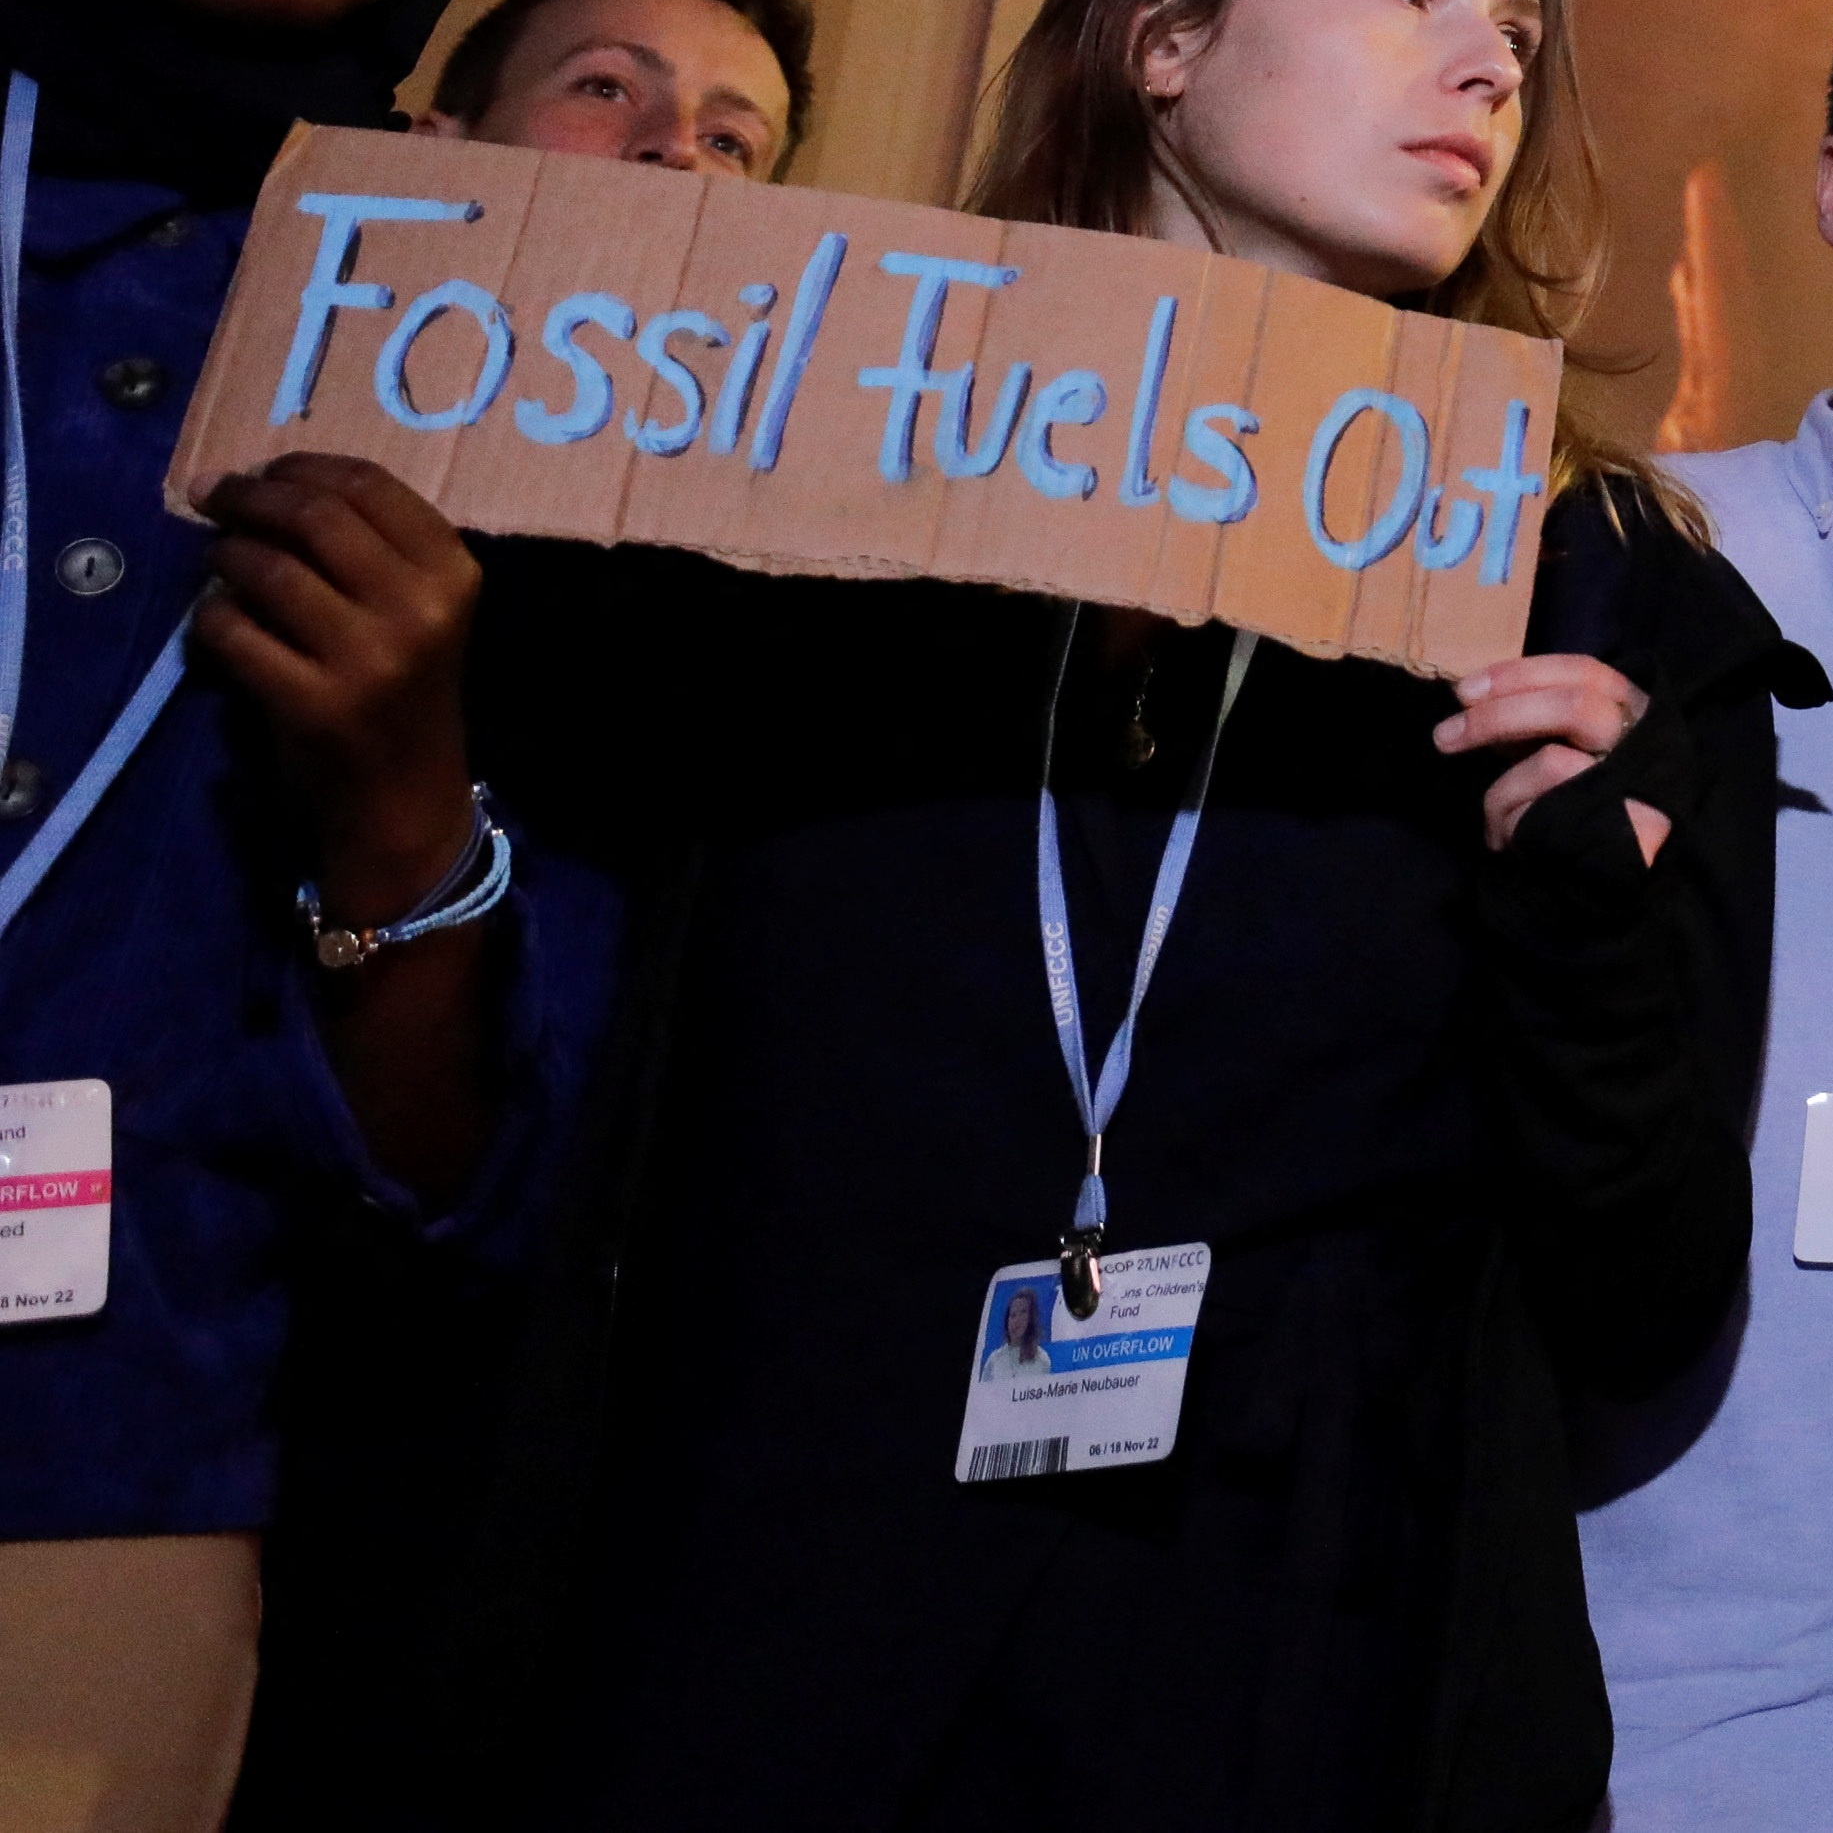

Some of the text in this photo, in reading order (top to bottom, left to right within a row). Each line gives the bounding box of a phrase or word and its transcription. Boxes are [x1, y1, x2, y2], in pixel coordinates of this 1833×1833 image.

[269, 191, 1542, 584] Fossil Fuels Out
[1044, 920, 1075, 1028] UNFCCC
[1104, 1260, 1134, 1275] COP
[16, 1294, 49, 1308] Nov
[55, 1289, 74, 1304] 22
[1146, 1281, 1206, 1298] Children's
[1110, 1304, 1141, 1319] Fund
[1072, 1335, 1175, 1363] UN OVERFLOW
[1012, 1374, 1141, 1403] Luisa-Marie Neubauer
[1089, 1444, 1101, 1457] 06
[1110, 1441, 1122, 1454] 18
[1124, 1440, 1145, 1453] Nov
[1147, 1437, 1160, 1450] 22
